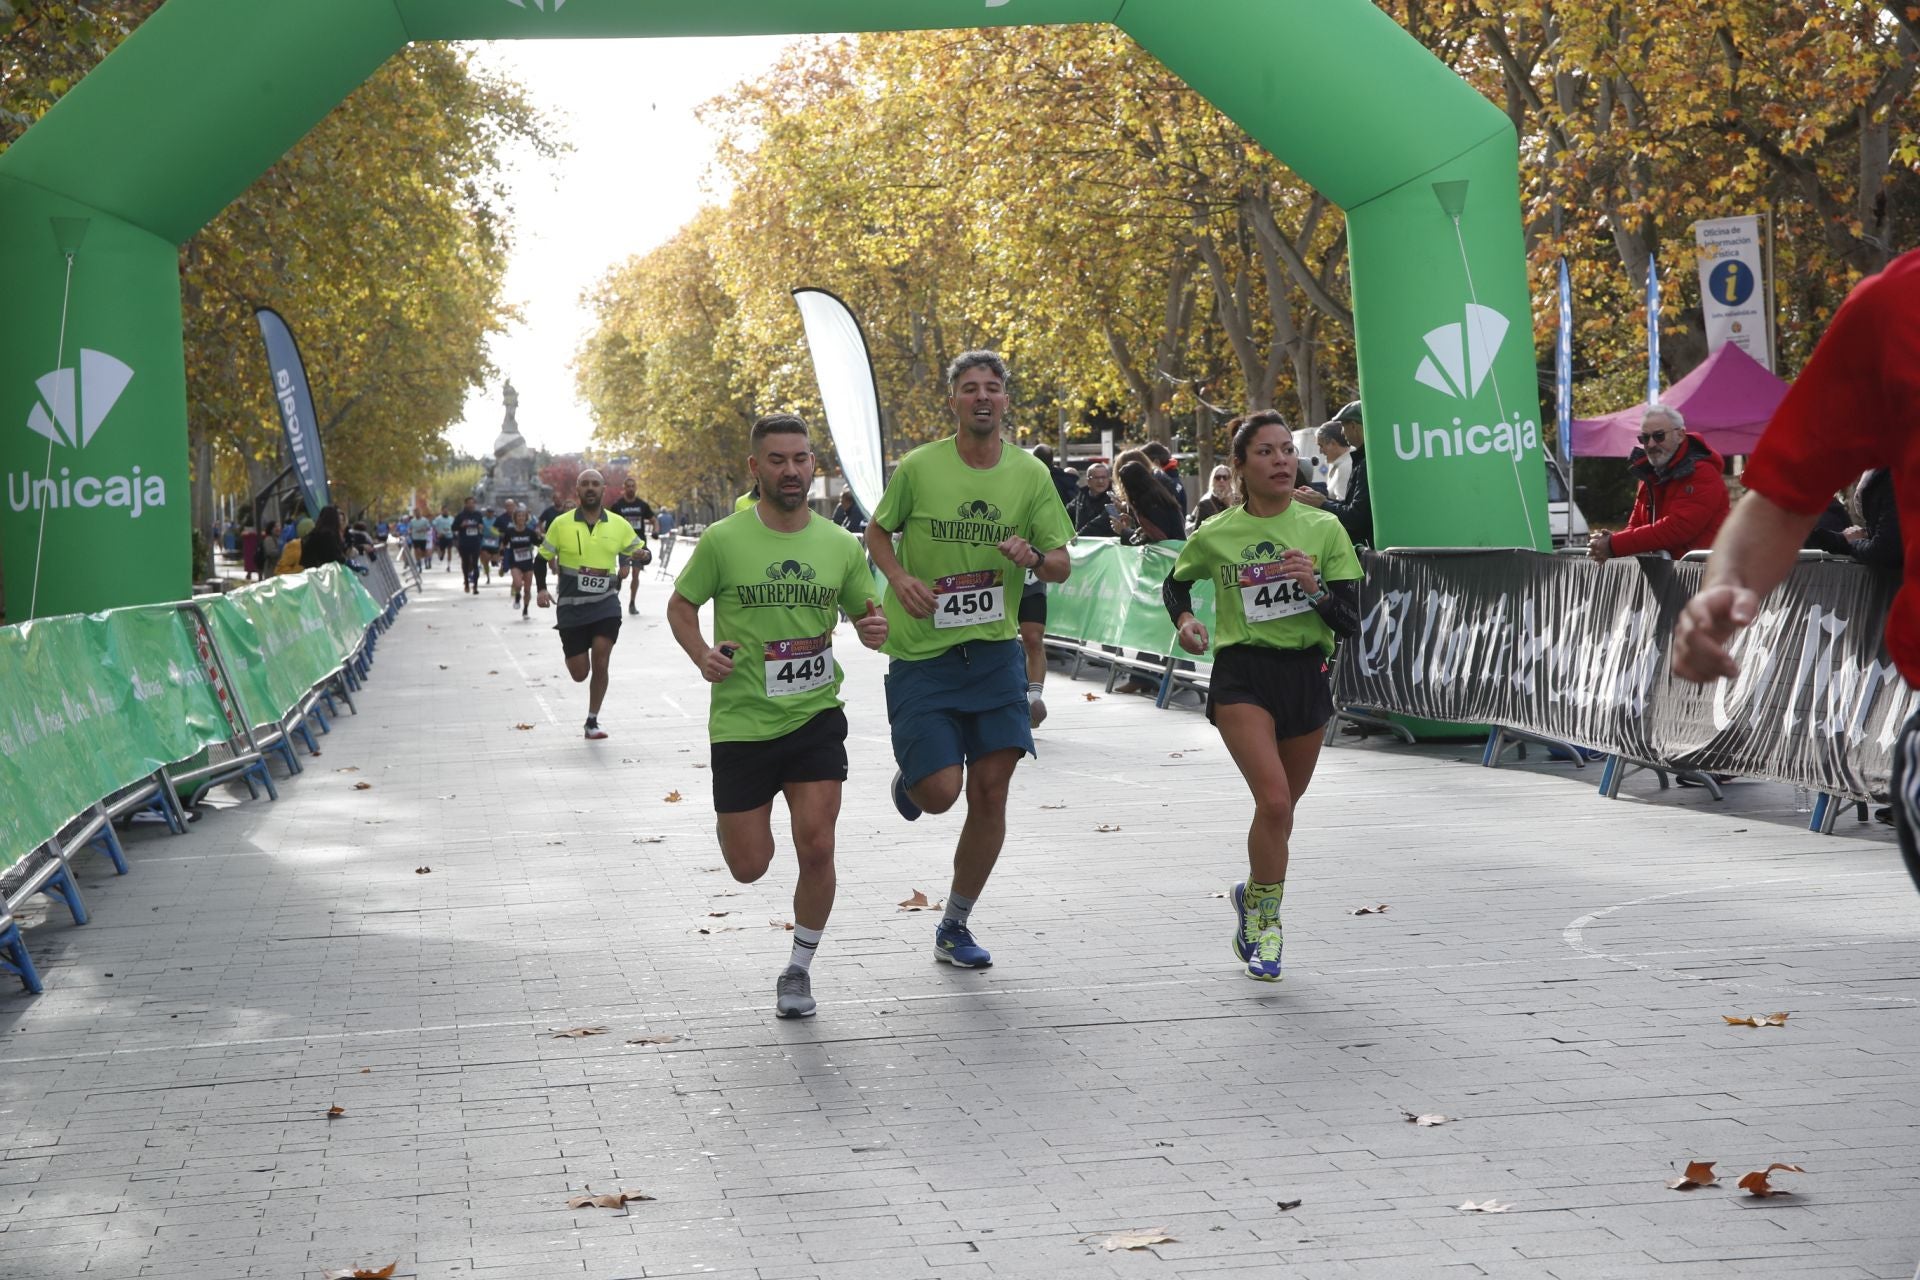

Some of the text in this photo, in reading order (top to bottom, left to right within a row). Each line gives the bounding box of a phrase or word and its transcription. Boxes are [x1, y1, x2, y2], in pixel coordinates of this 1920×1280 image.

[1704, 226, 1741, 237] Oficina de
[1393, 411, 1537, 462] Unicaja
[8, 465, 165, 518] Unicaja
[582, 577, 605, 588] 862
[1254, 582, 1307, 608] 448
[944, 591, 993, 616] 450
[777, 656, 825, 683] 449
